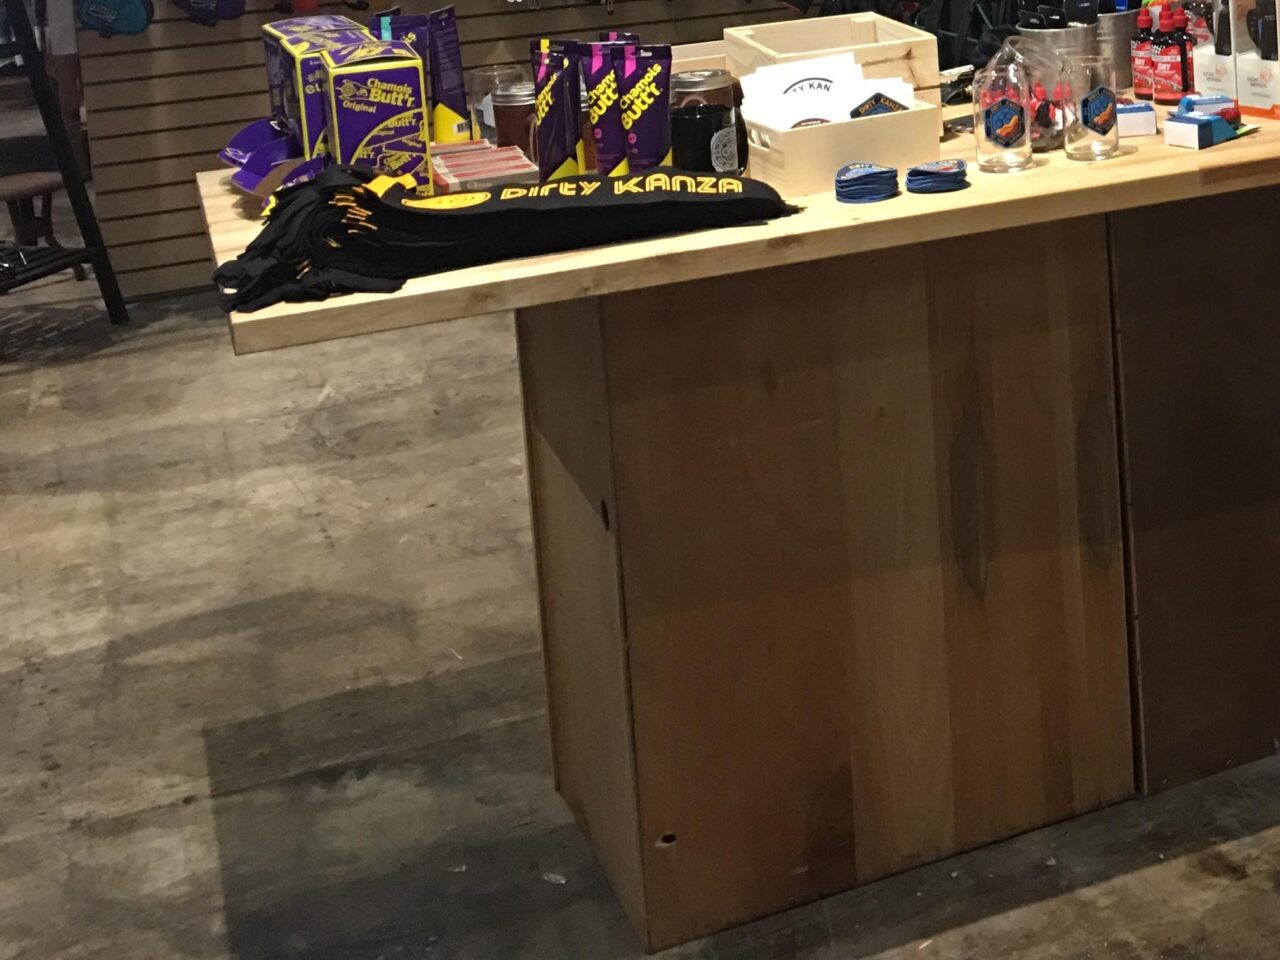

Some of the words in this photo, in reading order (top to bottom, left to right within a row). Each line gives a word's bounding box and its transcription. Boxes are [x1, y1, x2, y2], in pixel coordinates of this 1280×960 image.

[1134, 57, 1146, 65] DRY
[1157, 62, 1171, 71] DRY
[367, 78, 413, 95] Chamois
[620, 62, 662, 110] Chamois
[369, 89, 415, 108] Butt'r
[342, 100, 377, 114] Original
[858, 100, 876, 115] DIRTY
